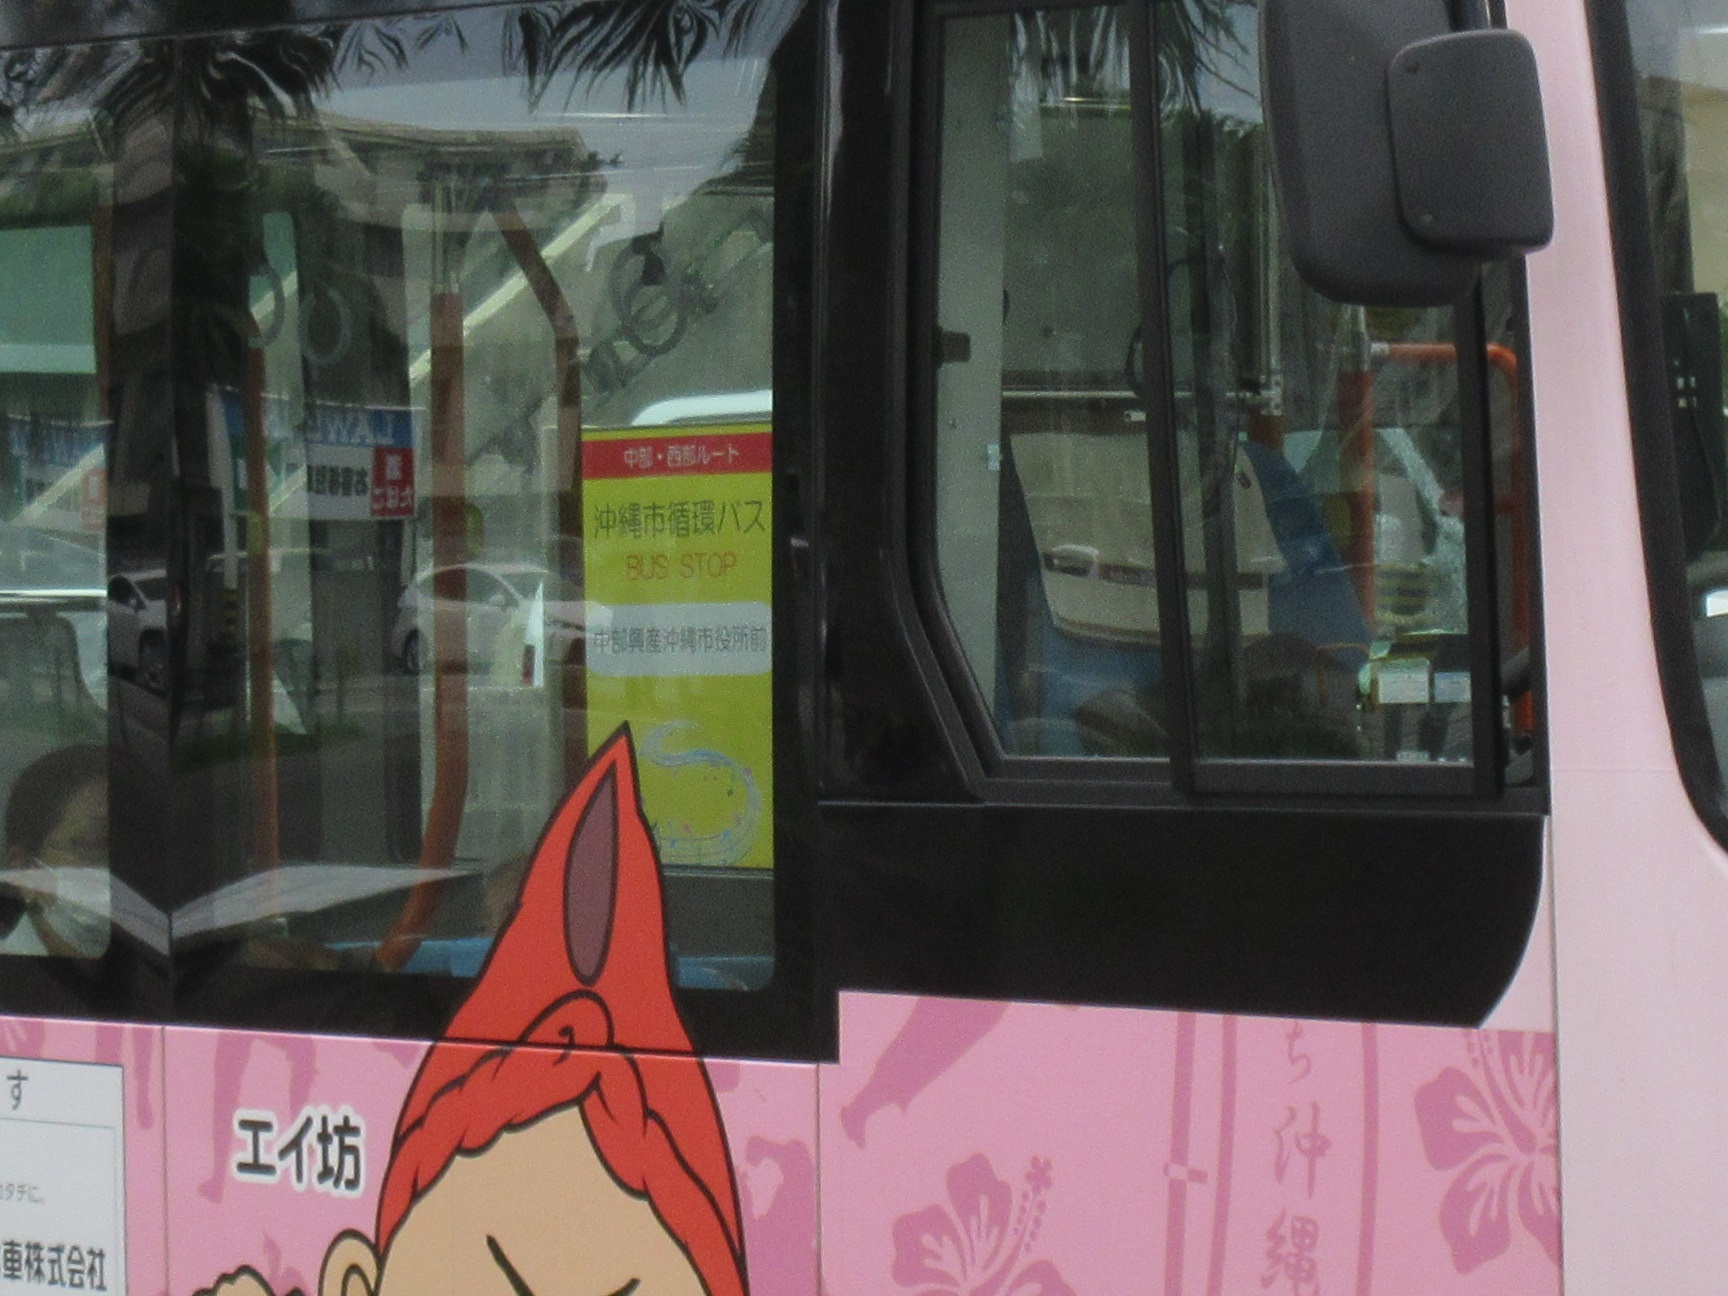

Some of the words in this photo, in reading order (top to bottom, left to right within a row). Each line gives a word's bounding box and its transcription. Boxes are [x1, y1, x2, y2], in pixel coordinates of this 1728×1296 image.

[593, 499, 767, 540] 沖縄市循環バス
[625, 553, 669, 582] BUS
[679, 551, 738, 579] STOP
[236, 1114, 362, 1191] エイ坊
